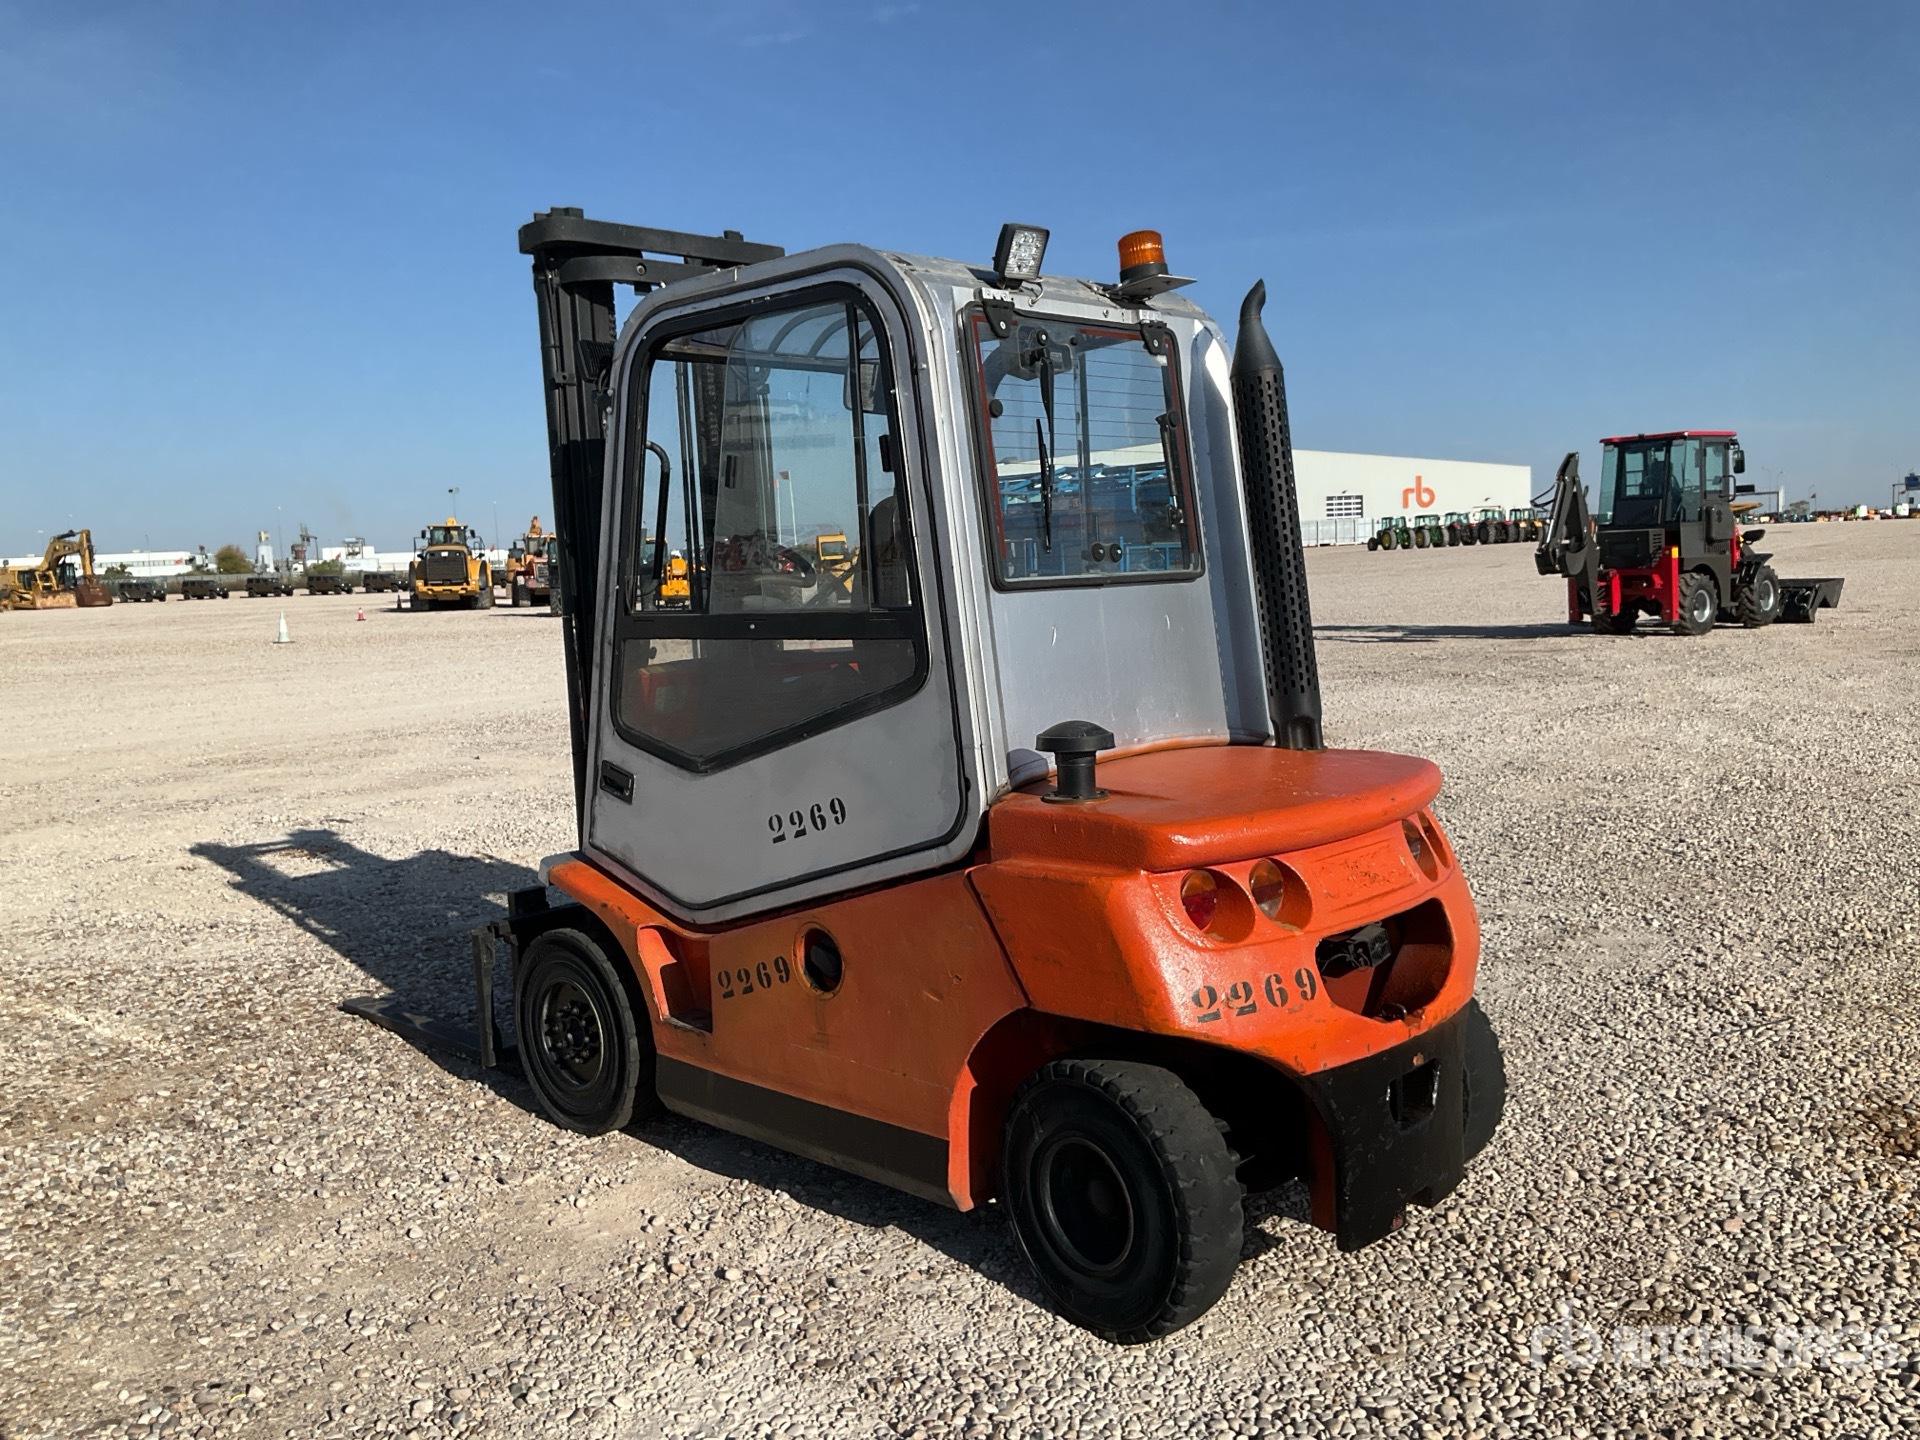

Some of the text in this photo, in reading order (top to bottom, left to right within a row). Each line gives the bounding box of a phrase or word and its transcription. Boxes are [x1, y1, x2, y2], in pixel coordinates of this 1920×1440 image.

[1402, 475, 1436, 509] rb
[768, 797, 847, 844] 2269
[717, 955, 791, 1000] 2269
[1192, 967, 1318, 1024] 2269
